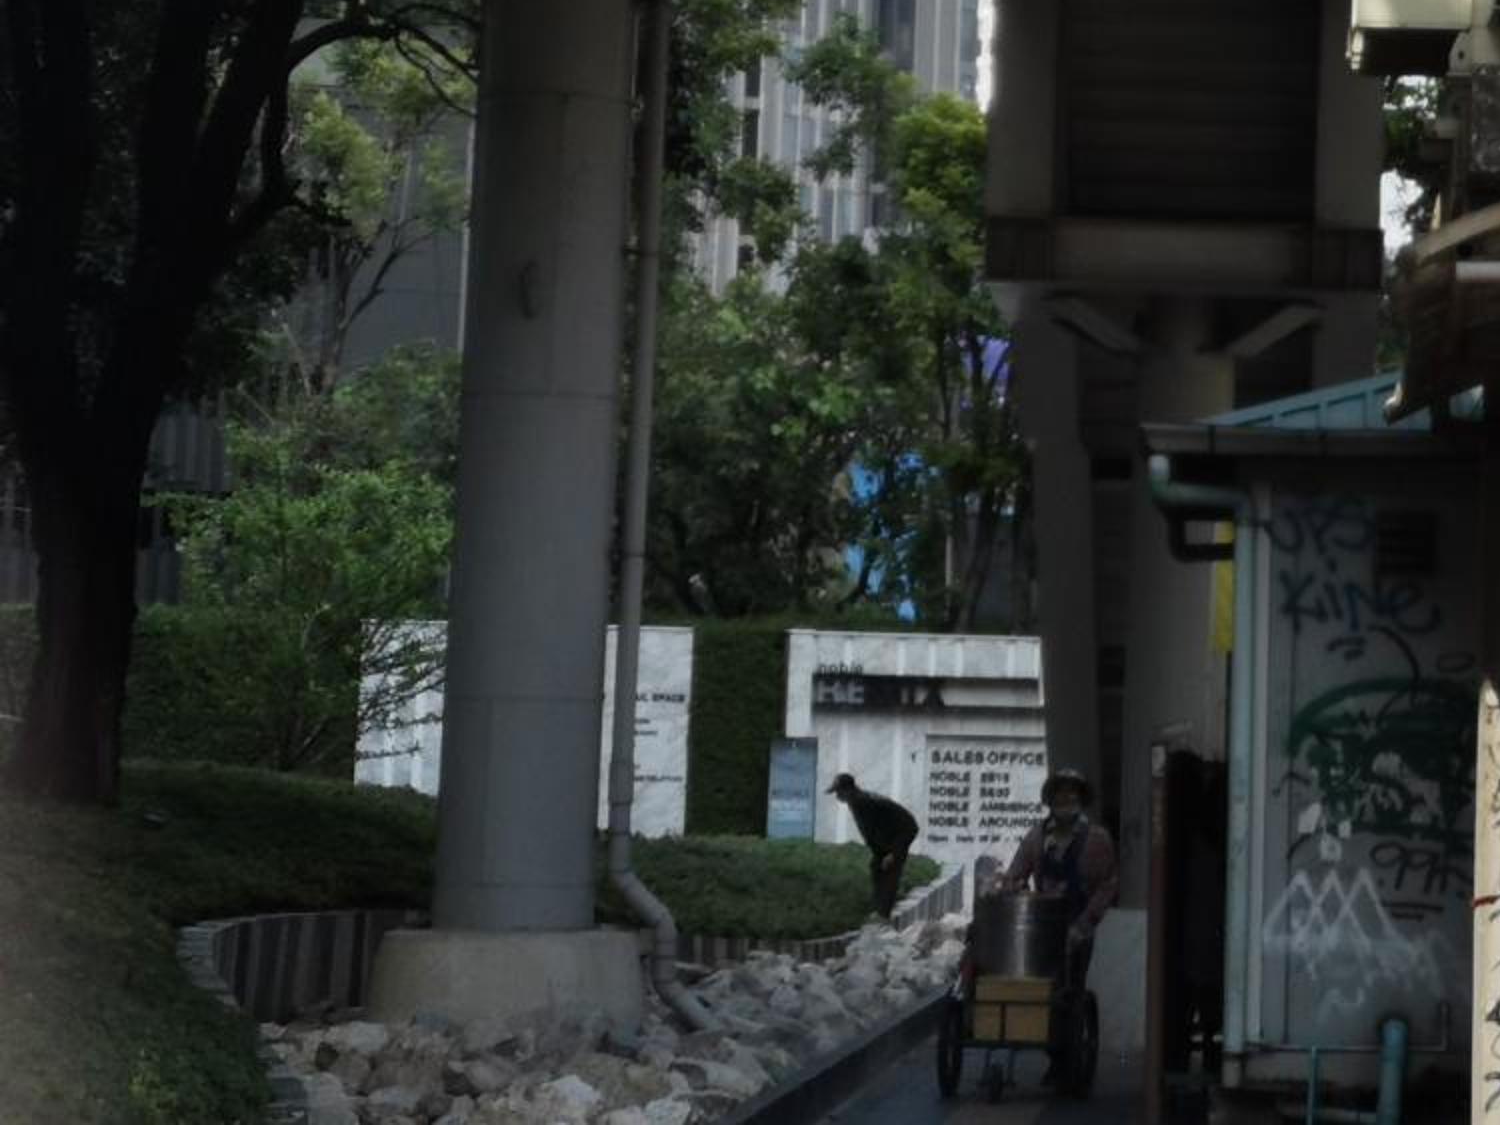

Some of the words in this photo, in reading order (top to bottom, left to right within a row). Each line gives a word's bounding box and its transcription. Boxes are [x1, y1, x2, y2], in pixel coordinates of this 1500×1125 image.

[931, 750, 984, 765] SALES
[987, 751, 1045, 766] OFFICE
[929, 771, 971, 783] NOBLE
[929, 786, 970, 798] NOBLE
[928, 801, 969, 813] NOBLE
[928, 816, 969, 828] NOBLE
